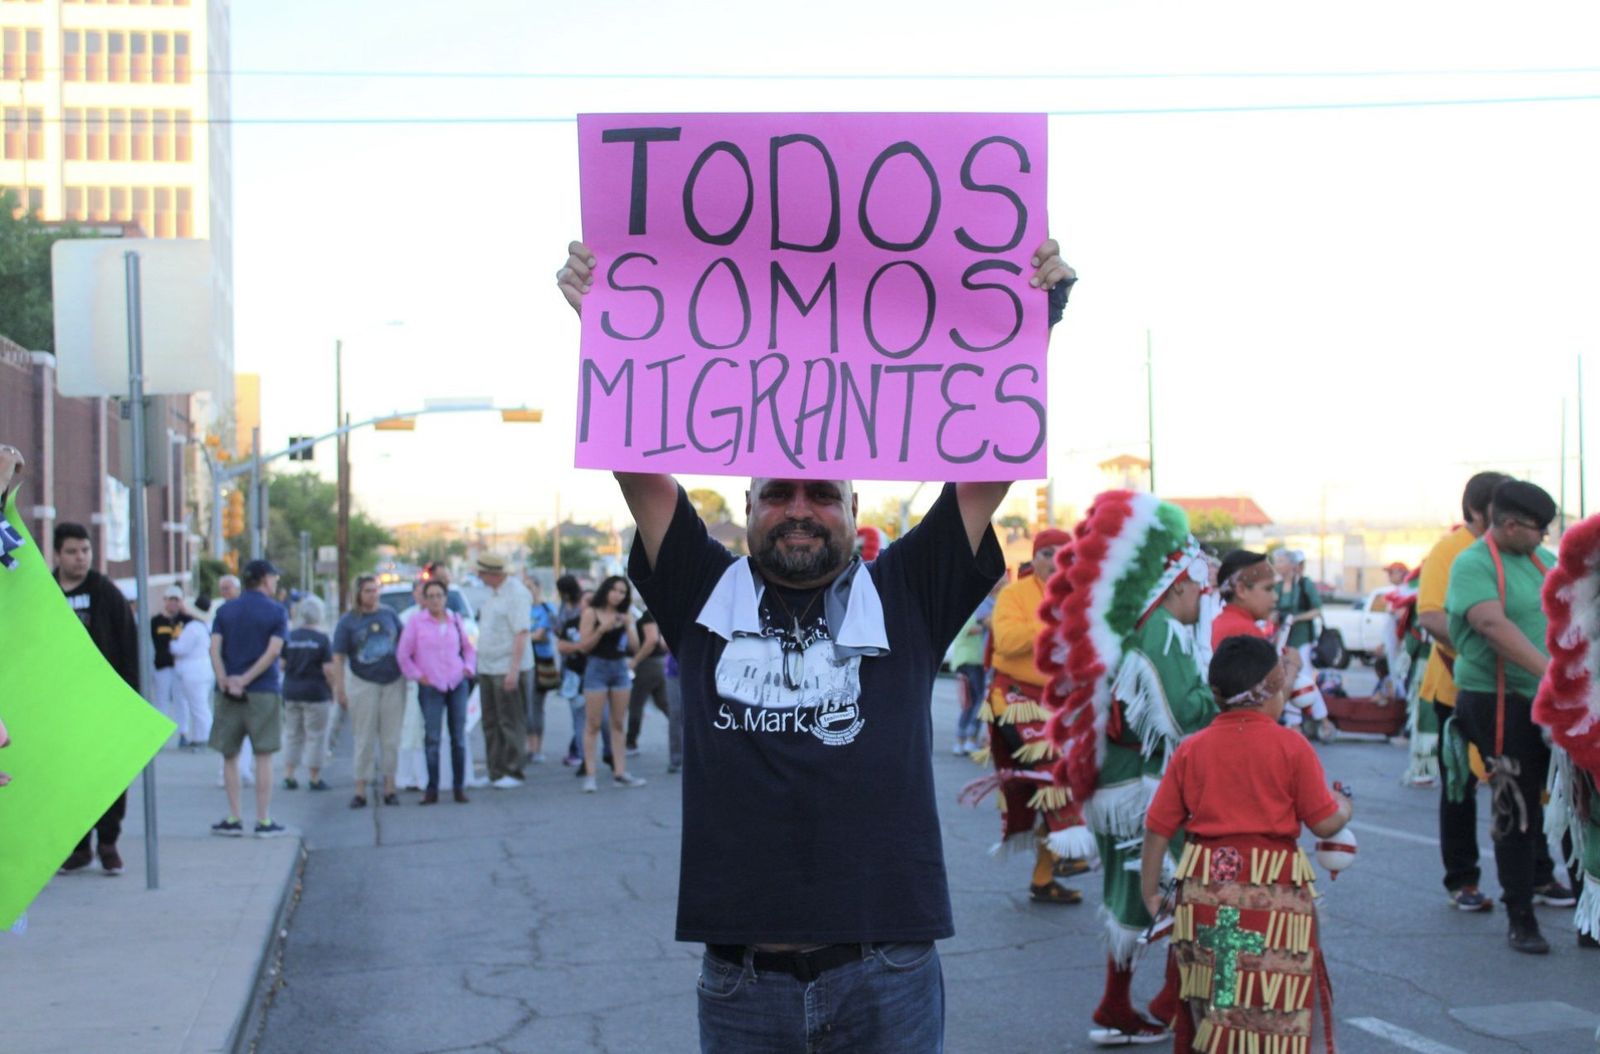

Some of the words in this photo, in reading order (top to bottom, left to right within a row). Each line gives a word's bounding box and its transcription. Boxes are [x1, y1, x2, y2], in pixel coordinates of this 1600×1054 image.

[602, 127, 1031, 253] TODOS
[601, 252, 1024, 359] SOMOS
[579, 353, 1048, 469] MIGRANTES
[744, 703, 809, 733] Mark
